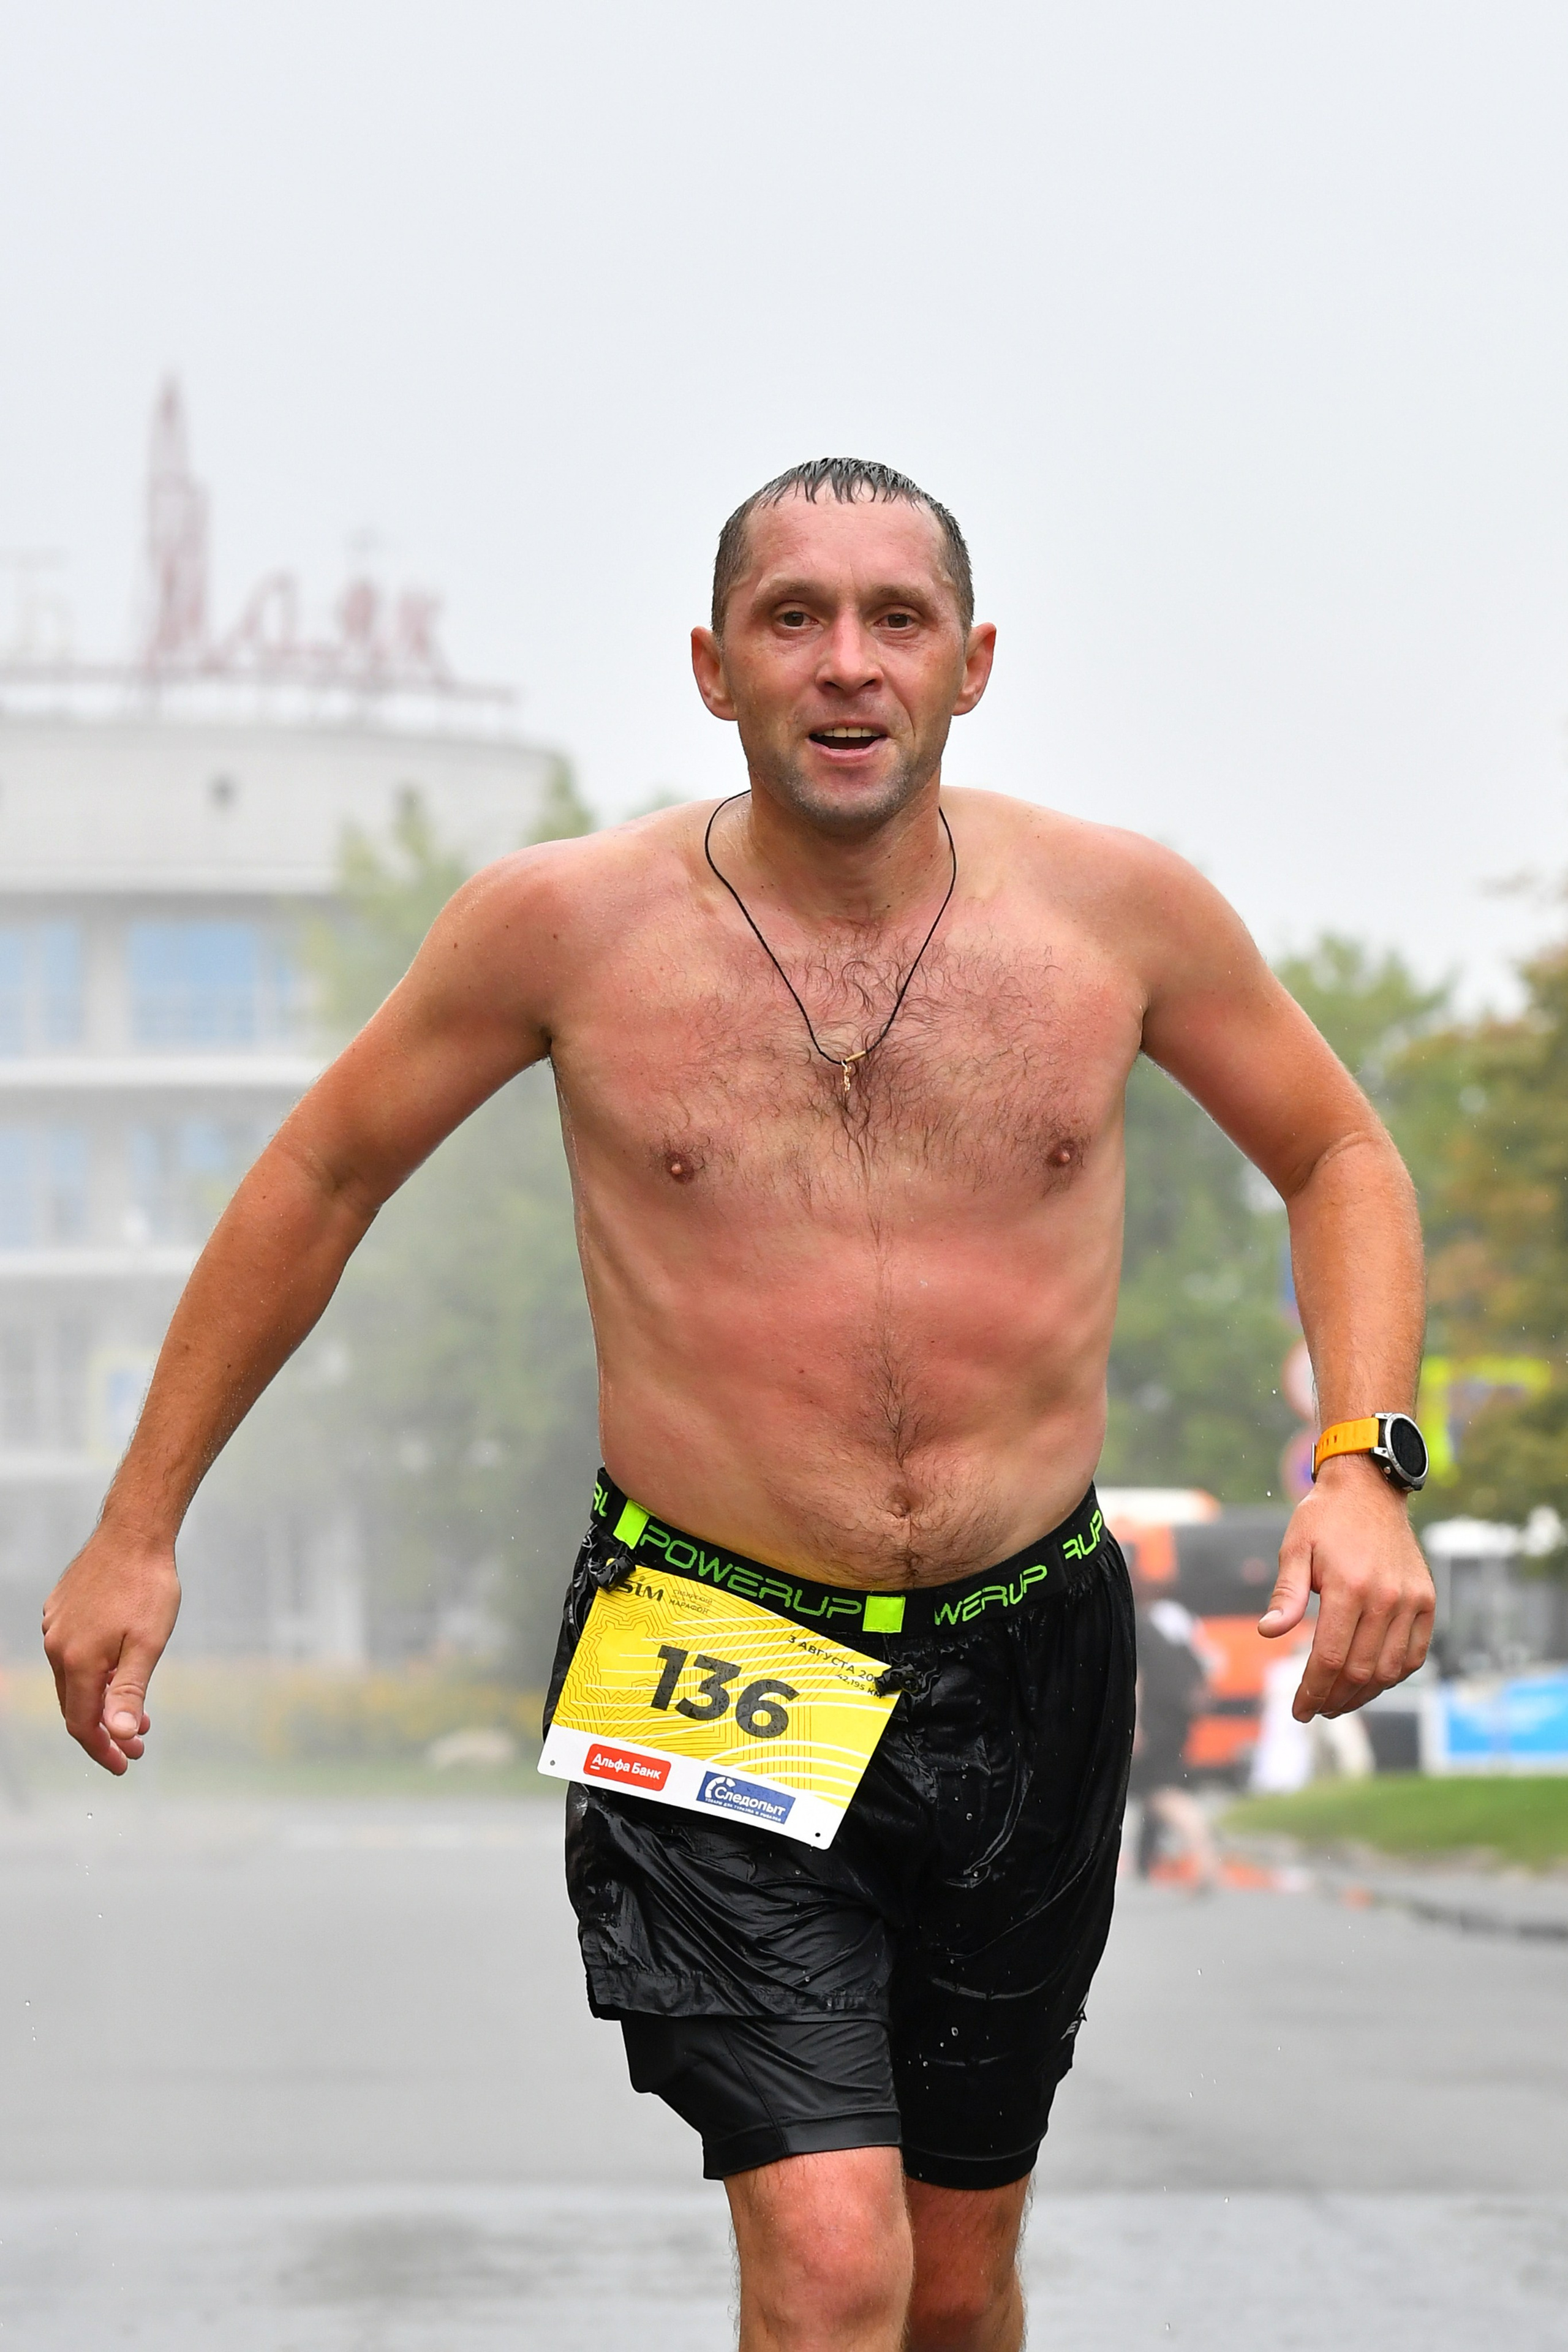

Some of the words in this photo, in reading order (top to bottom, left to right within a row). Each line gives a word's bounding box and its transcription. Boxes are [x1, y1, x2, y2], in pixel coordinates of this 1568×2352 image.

[640, 1524, 862, 1618] POWERUP
[669, 1599, 709, 1615] МАРАФОН
[788, 1634, 797, 1644] 3
[798, 1641, 855, 1674] АВГУСТА
[858, 1670, 876, 1684] 20
[650, 1645, 800, 1738] 136
[837, 1673, 865, 1691] 42,195
[590, 1753, 631, 1773] Альфа
[631, 1762, 662, 1780] Банк
[714, 1785, 786, 1817] Следопыт
